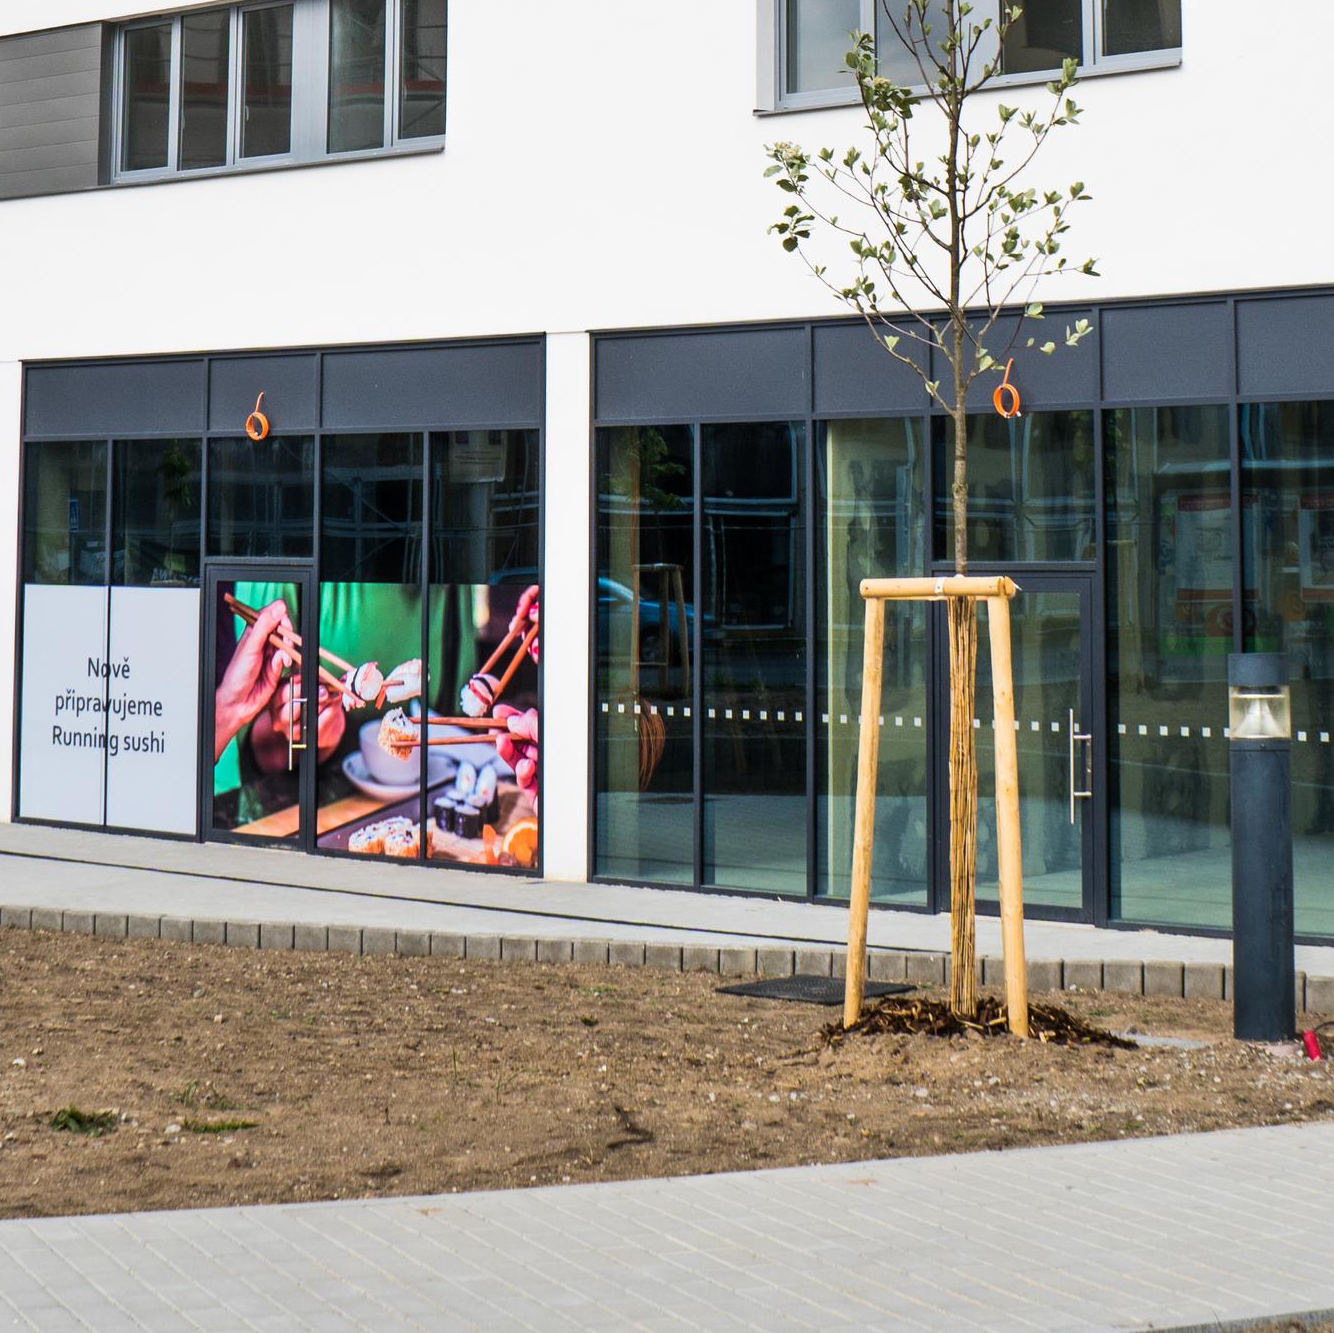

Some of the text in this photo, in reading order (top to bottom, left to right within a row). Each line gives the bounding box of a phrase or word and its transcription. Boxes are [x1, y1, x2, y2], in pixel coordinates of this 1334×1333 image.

[87, 656, 130, 679] Nově
[55, 688, 163, 721] připravujeme
[52, 725, 165, 756] Running sushi
